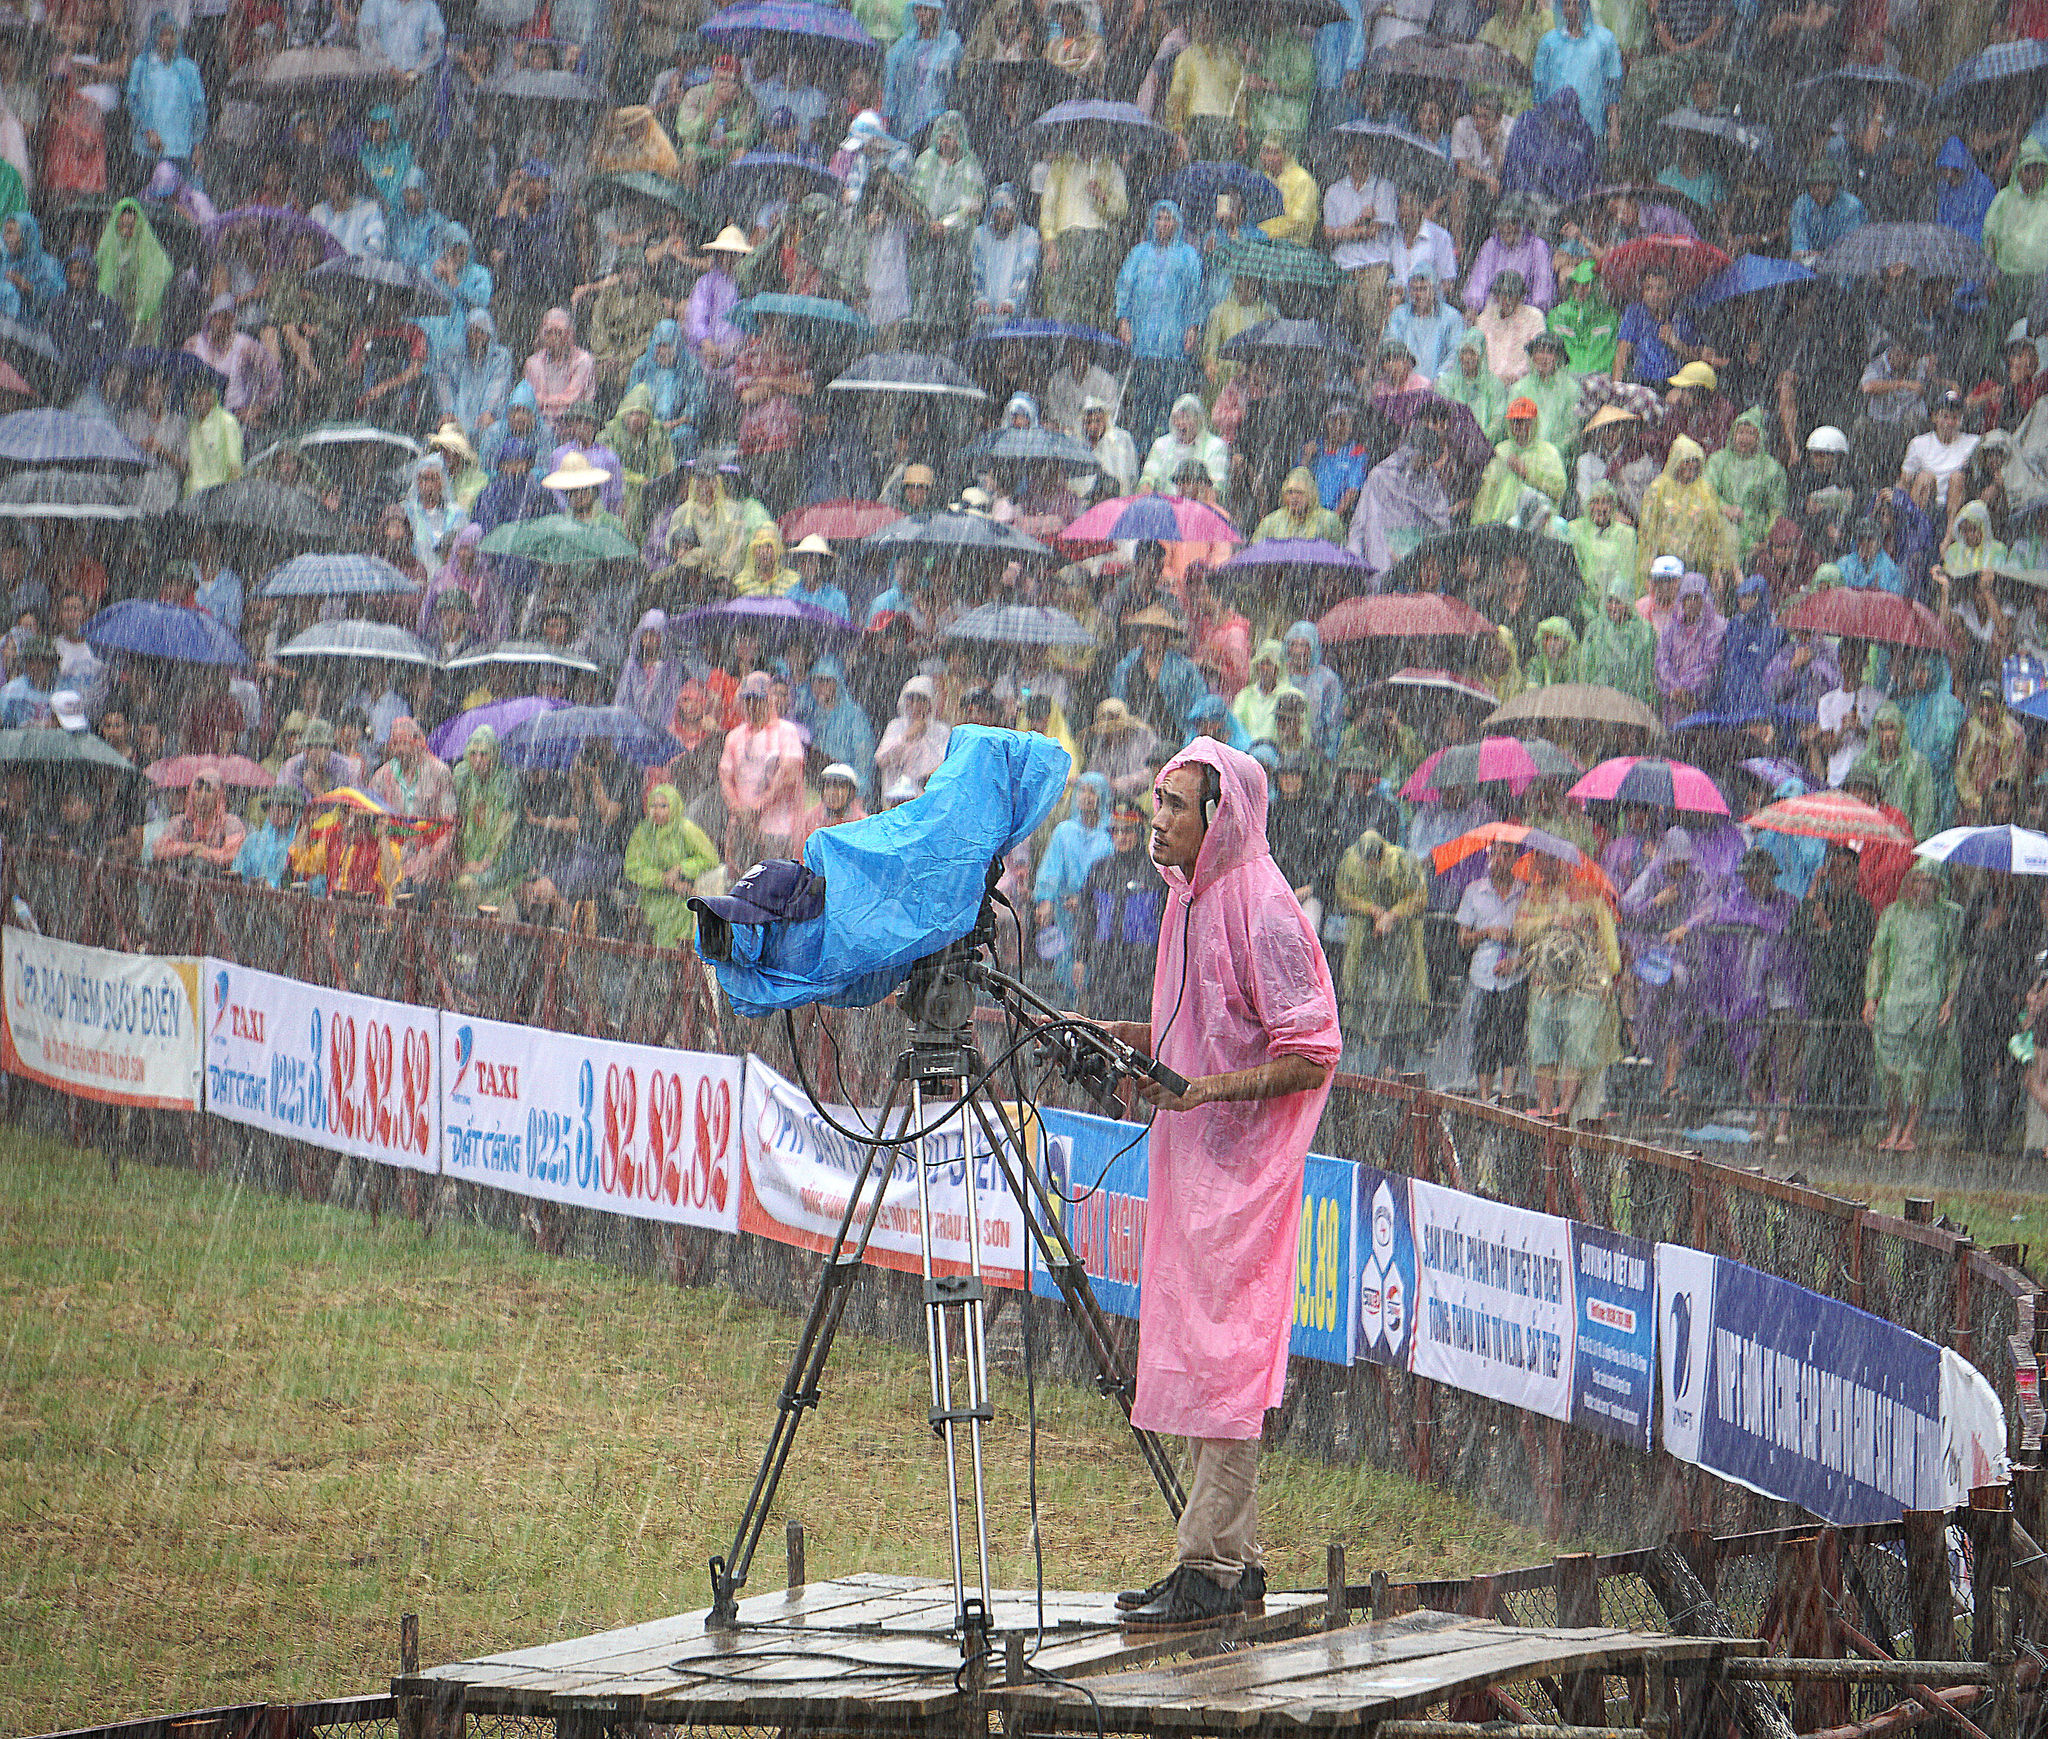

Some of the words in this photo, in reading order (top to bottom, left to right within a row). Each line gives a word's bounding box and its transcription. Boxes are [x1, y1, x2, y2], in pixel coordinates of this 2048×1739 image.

[141, 976, 182, 1050] ĐIỆN
[230, 1003, 265, 1044] TAXI
[270, 1051, 305, 1126] 0225
[474, 1060, 518, 1100] TAXI
[526, 1107, 571, 1187] 0225
[935, 1208, 962, 1241] TRÂU
[983, 1218, 1010, 1249] SƠN
[1073, 1183, 1106, 1280] TAXI
